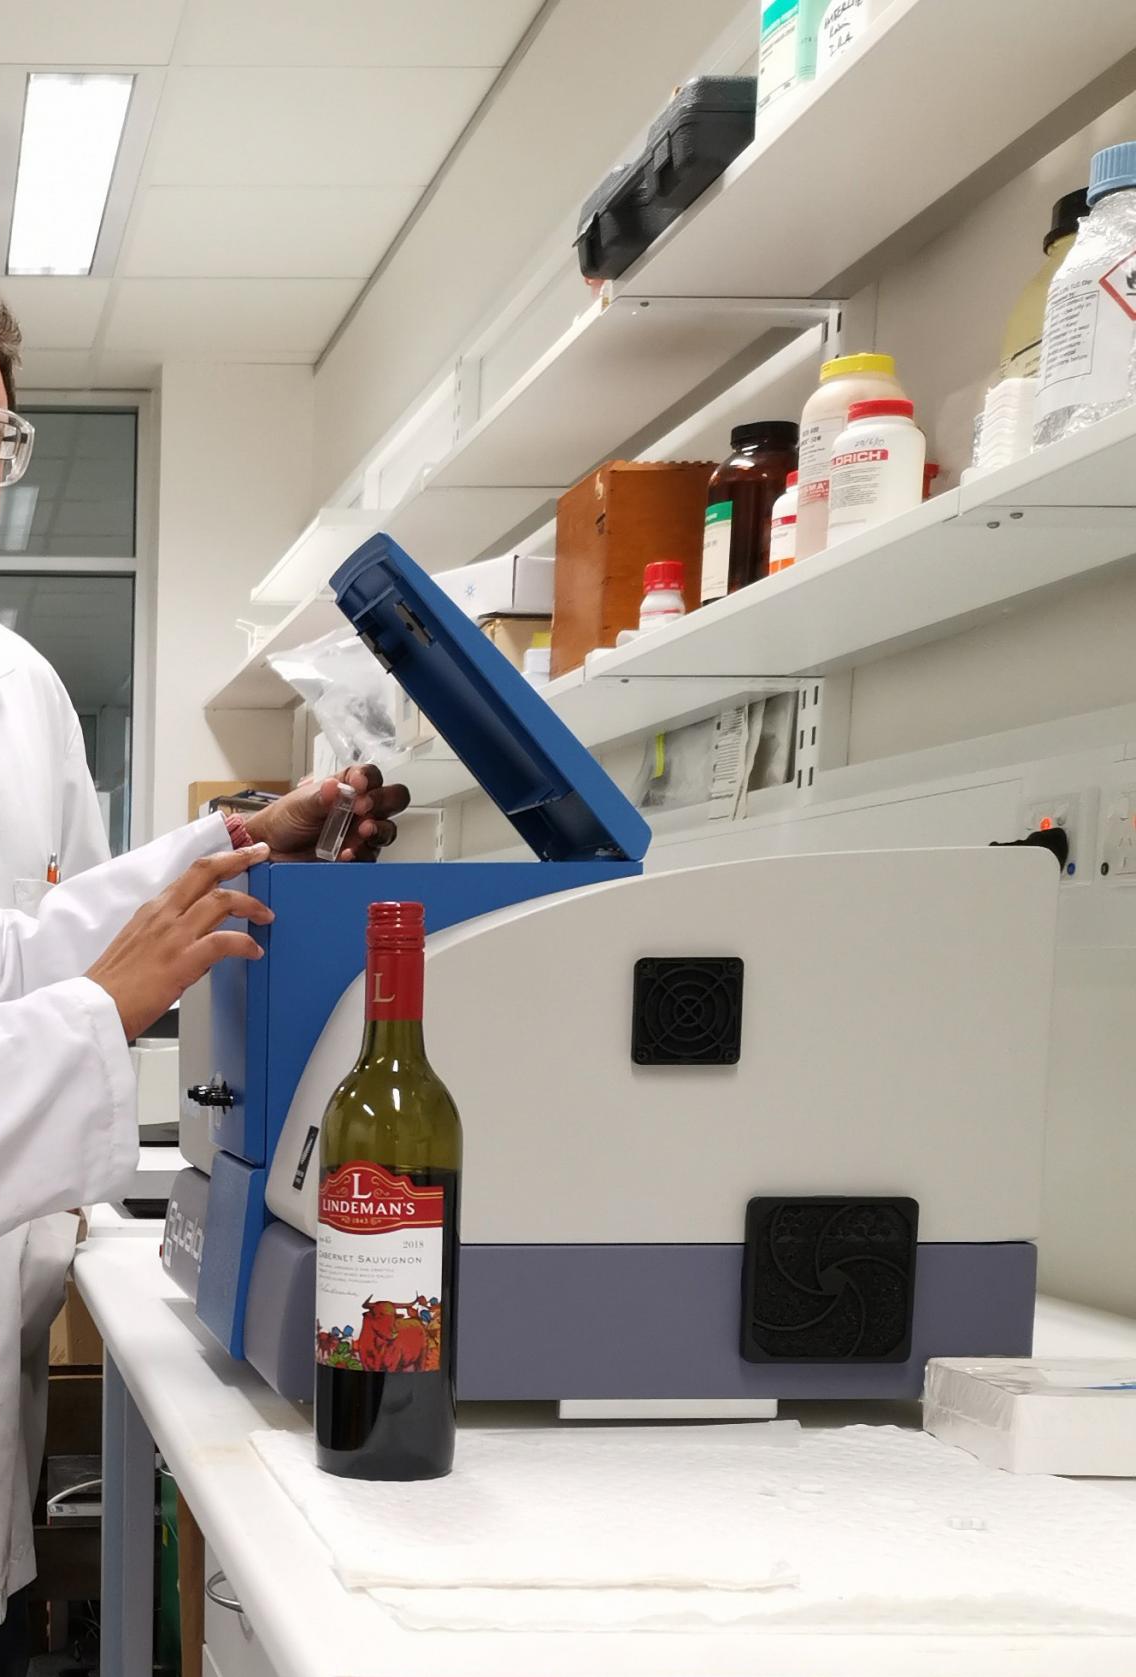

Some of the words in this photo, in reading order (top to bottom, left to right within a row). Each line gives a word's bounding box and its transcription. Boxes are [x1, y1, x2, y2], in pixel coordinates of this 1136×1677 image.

[373, 972, 396, 1003] L
[352, 1173, 372, 1199] L
[322, 1199, 416, 1216] LINDEMAN'S
[402, 1240, 425, 1250] 2018
[357, 1254, 423, 1265] SAUVIGNON
